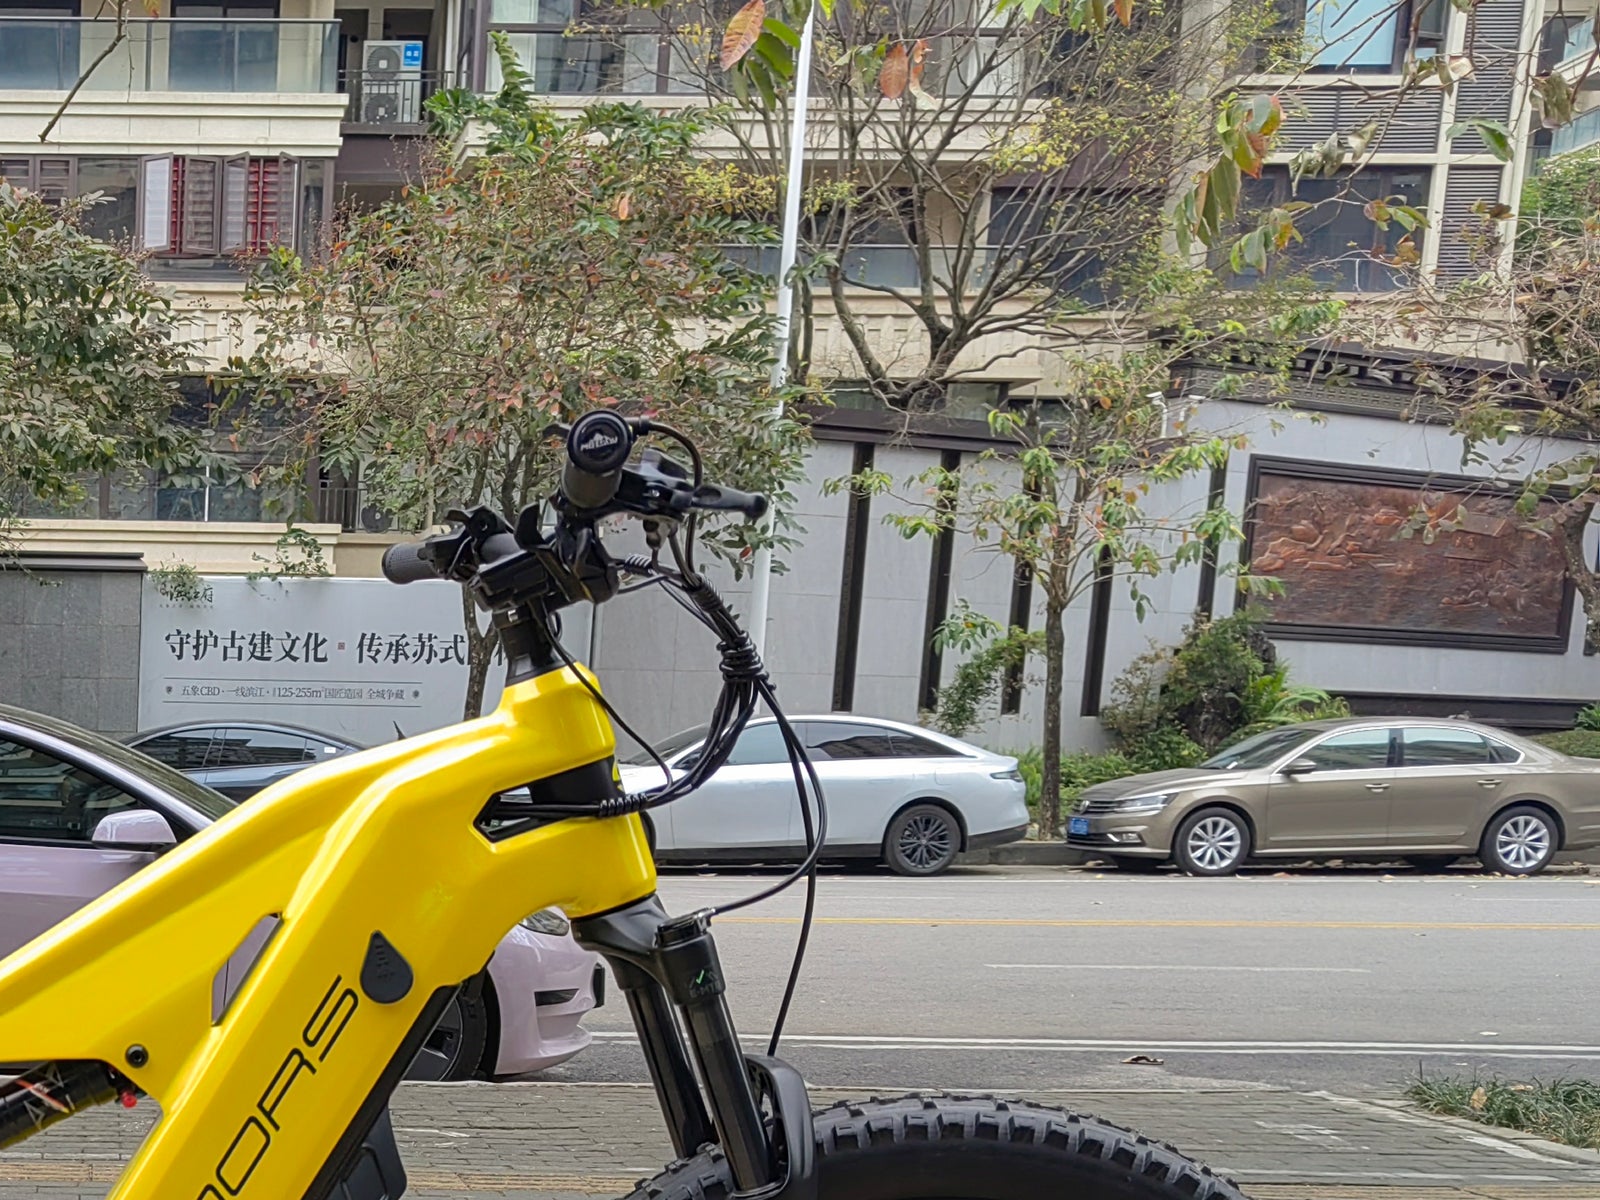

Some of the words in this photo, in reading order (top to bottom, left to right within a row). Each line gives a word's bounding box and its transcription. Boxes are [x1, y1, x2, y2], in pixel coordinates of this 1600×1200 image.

[164, 628, 329, 664] 守护古建文化
[356, 631, 506, 667] 传承苏式
